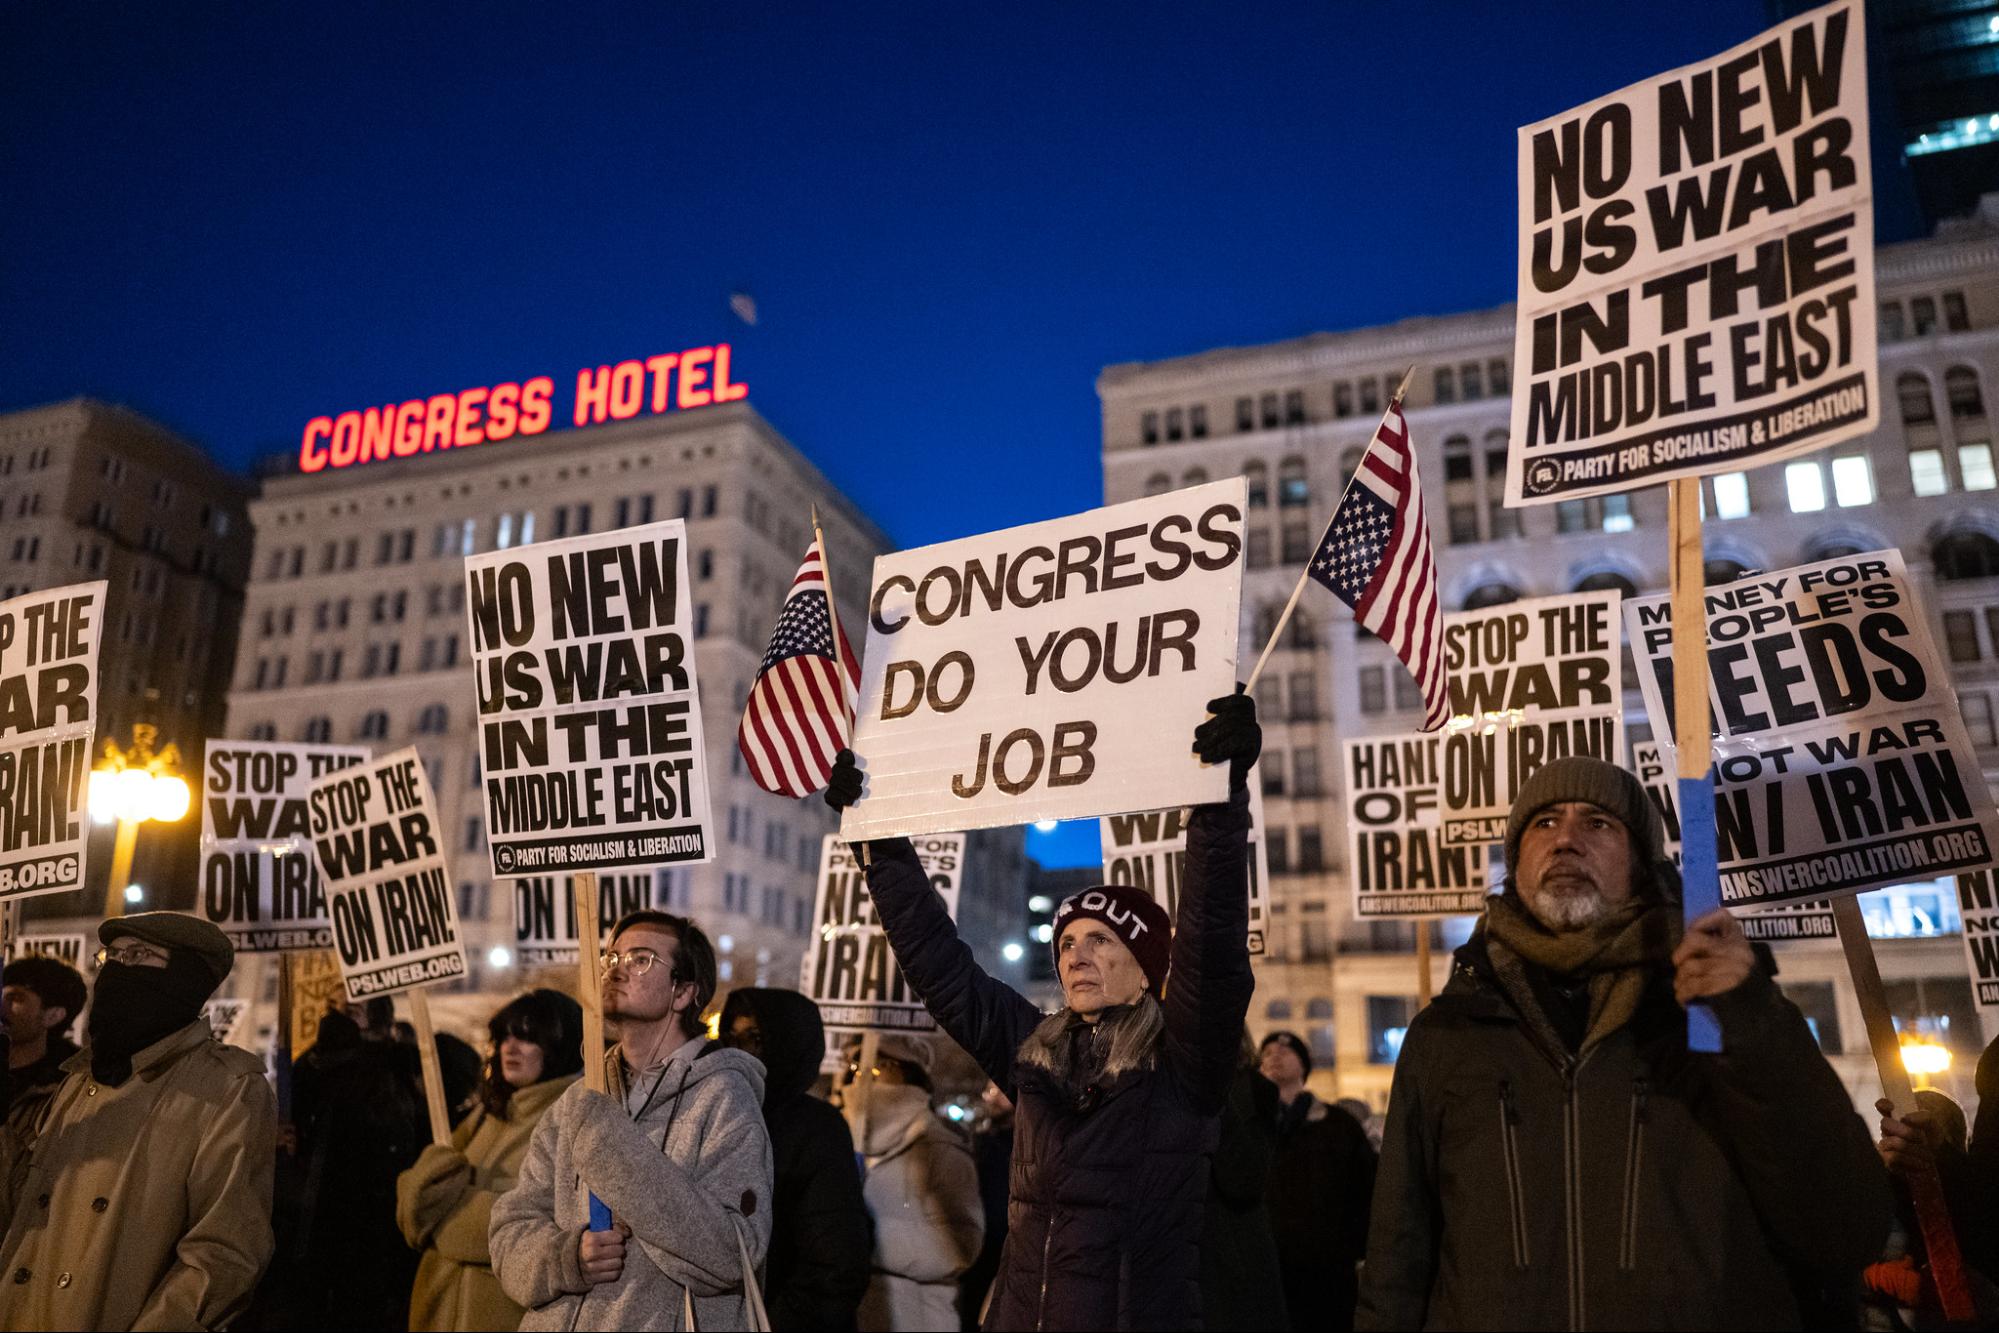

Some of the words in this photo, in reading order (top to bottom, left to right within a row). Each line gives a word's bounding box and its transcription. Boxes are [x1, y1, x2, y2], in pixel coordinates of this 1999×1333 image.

[1533, 102, 1632, 225] NO
[1658, 6, 1850, 178] NEW
[1531, 199, 1636, 293] US
[1645, 117, 1857, 253] WAR
[1532, 287, 1630, 376] IN
[1642, 212, 1856, 336] THE
[1526, 331, 1716, 449] MIDDLE
[1729, 285, 1858, 403] EAST
[299, 376, 554, 473] CONGRESS
[573, 343, 749, 427] HOTEL
[1563, 451, 1615, 482] PARTY
[1619, 444, 1649, 471] FOR
[1653, 430, 1748, 464] SOCIALISM
[1751, 421, 1766, 444] &
[1769, 386, 1864, 437] LIBERATION
[470, 562, 535, 652] NO
[547, 538, 679, 641] NEW
[870, 503, 1242, 634] CONGRESS
[1639, 578, 1789, 626] MNEY
[1799, 560, 1891, 593] FOR
[24, 594, 94, 668] THE
[1445, 613, 1529, 670] STOP
[1538, 602, 1609, 657] THE
[1645, 583, 1900, 654] POPLE'S
[0, 662, 89, 735] AR
[476, 651, 544, 714] US
[544, 632, 689, 705] WAR
[880, 650, 976, 721] DO
[1014, 608, 1201, 695] YOUR
[1449, 657, 1612, 716] WAR
[209, 750, 297, 794] STOP
[484, 717, 549, 772] IN
[554, 700, 692, 763] THE
[951, 719, 1098, 799] JOB
[1445, 731, 1496, 811] ON
[1713, 747, 1794, 786] OT
[1805, 719, 1947, 765] WAR
[0, 737, 86, 850] RAN!
[208, 797, 312, 839] WA
[310, 775, 371, 834] STOP
[376, 759, 423, 815] THE
[487, 767, 606, 835] MIDDLE
[613, 758, 693, 824] EAST
[1354, 788, 1437, 825] OF
[1806, 748, 1974, 846] IRAN
[316, 812, 437, 881] WAR
[516, 847, 546, 866] PARTY
[548, 845, 568, 864] FOR
[570, 840, 625, 862] SOCIALISM
[627, 840, 637, 857] &
[638, 834, 702, 856] LIBERATION
[1357, 828, 1484, 891] IRAN!
[1720, 830, 1985, 900] ANSWERCOALITION.ORG
[205, 852, 259, 922] ON
[272, 853, 329, 920] IRA
[333, 887, 380, 966] ON
[376, 867, 455, 957] IRAN!
[516, 876, 554, 940] ON
[1081, 892, 1148, 940] OUT
[1741, 915, 1833, 938] ALITION.ORG
[349, 954, 463, 996] PSLWEB.ORG
